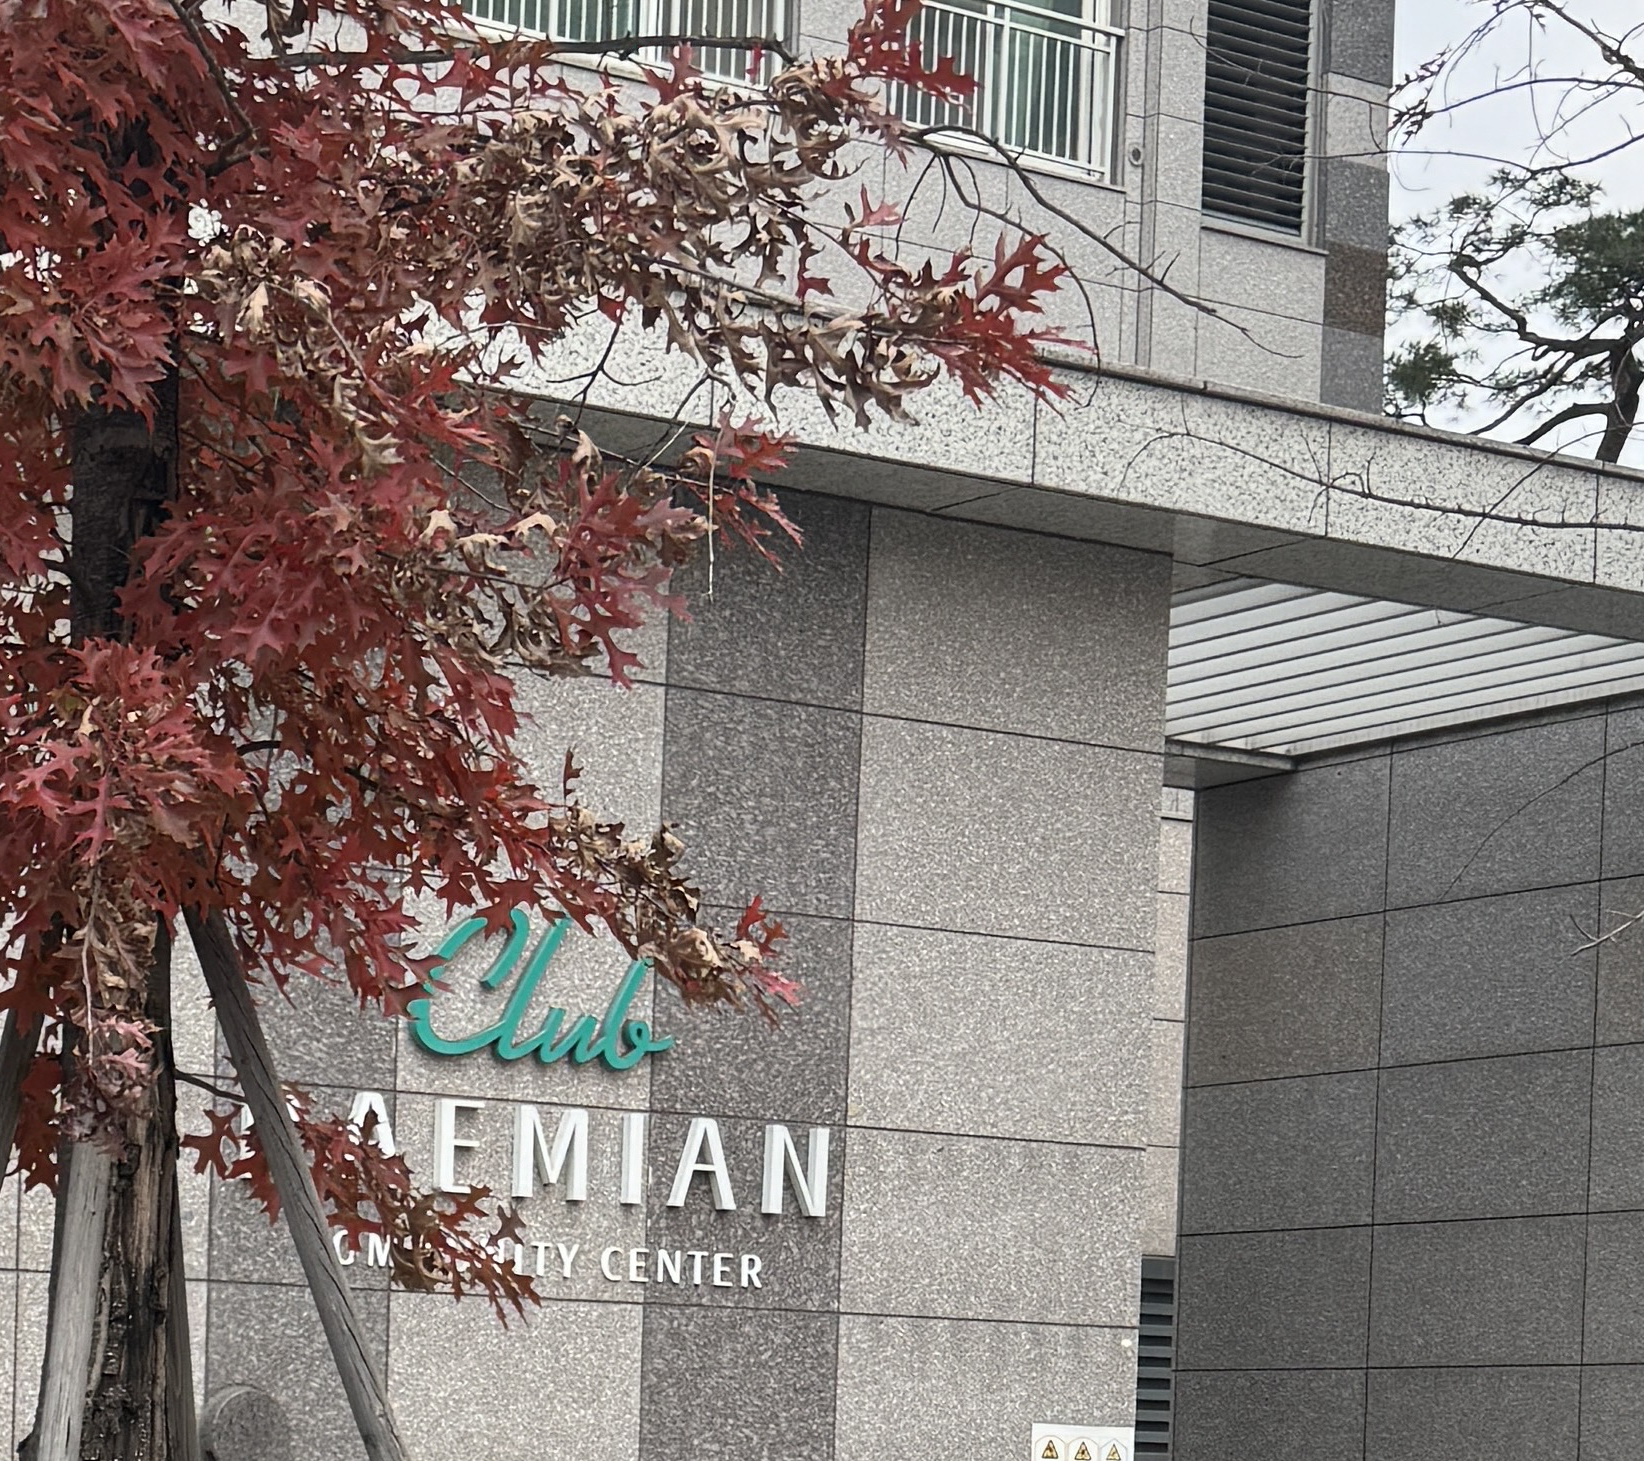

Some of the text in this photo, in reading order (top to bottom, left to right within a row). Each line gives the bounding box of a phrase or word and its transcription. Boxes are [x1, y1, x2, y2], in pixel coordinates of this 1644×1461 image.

[407, 908, 675, 1070] Club
[240, 1091, 829, 1217] AEMIAN
[600, 1247, 762, 1288] CENTER
